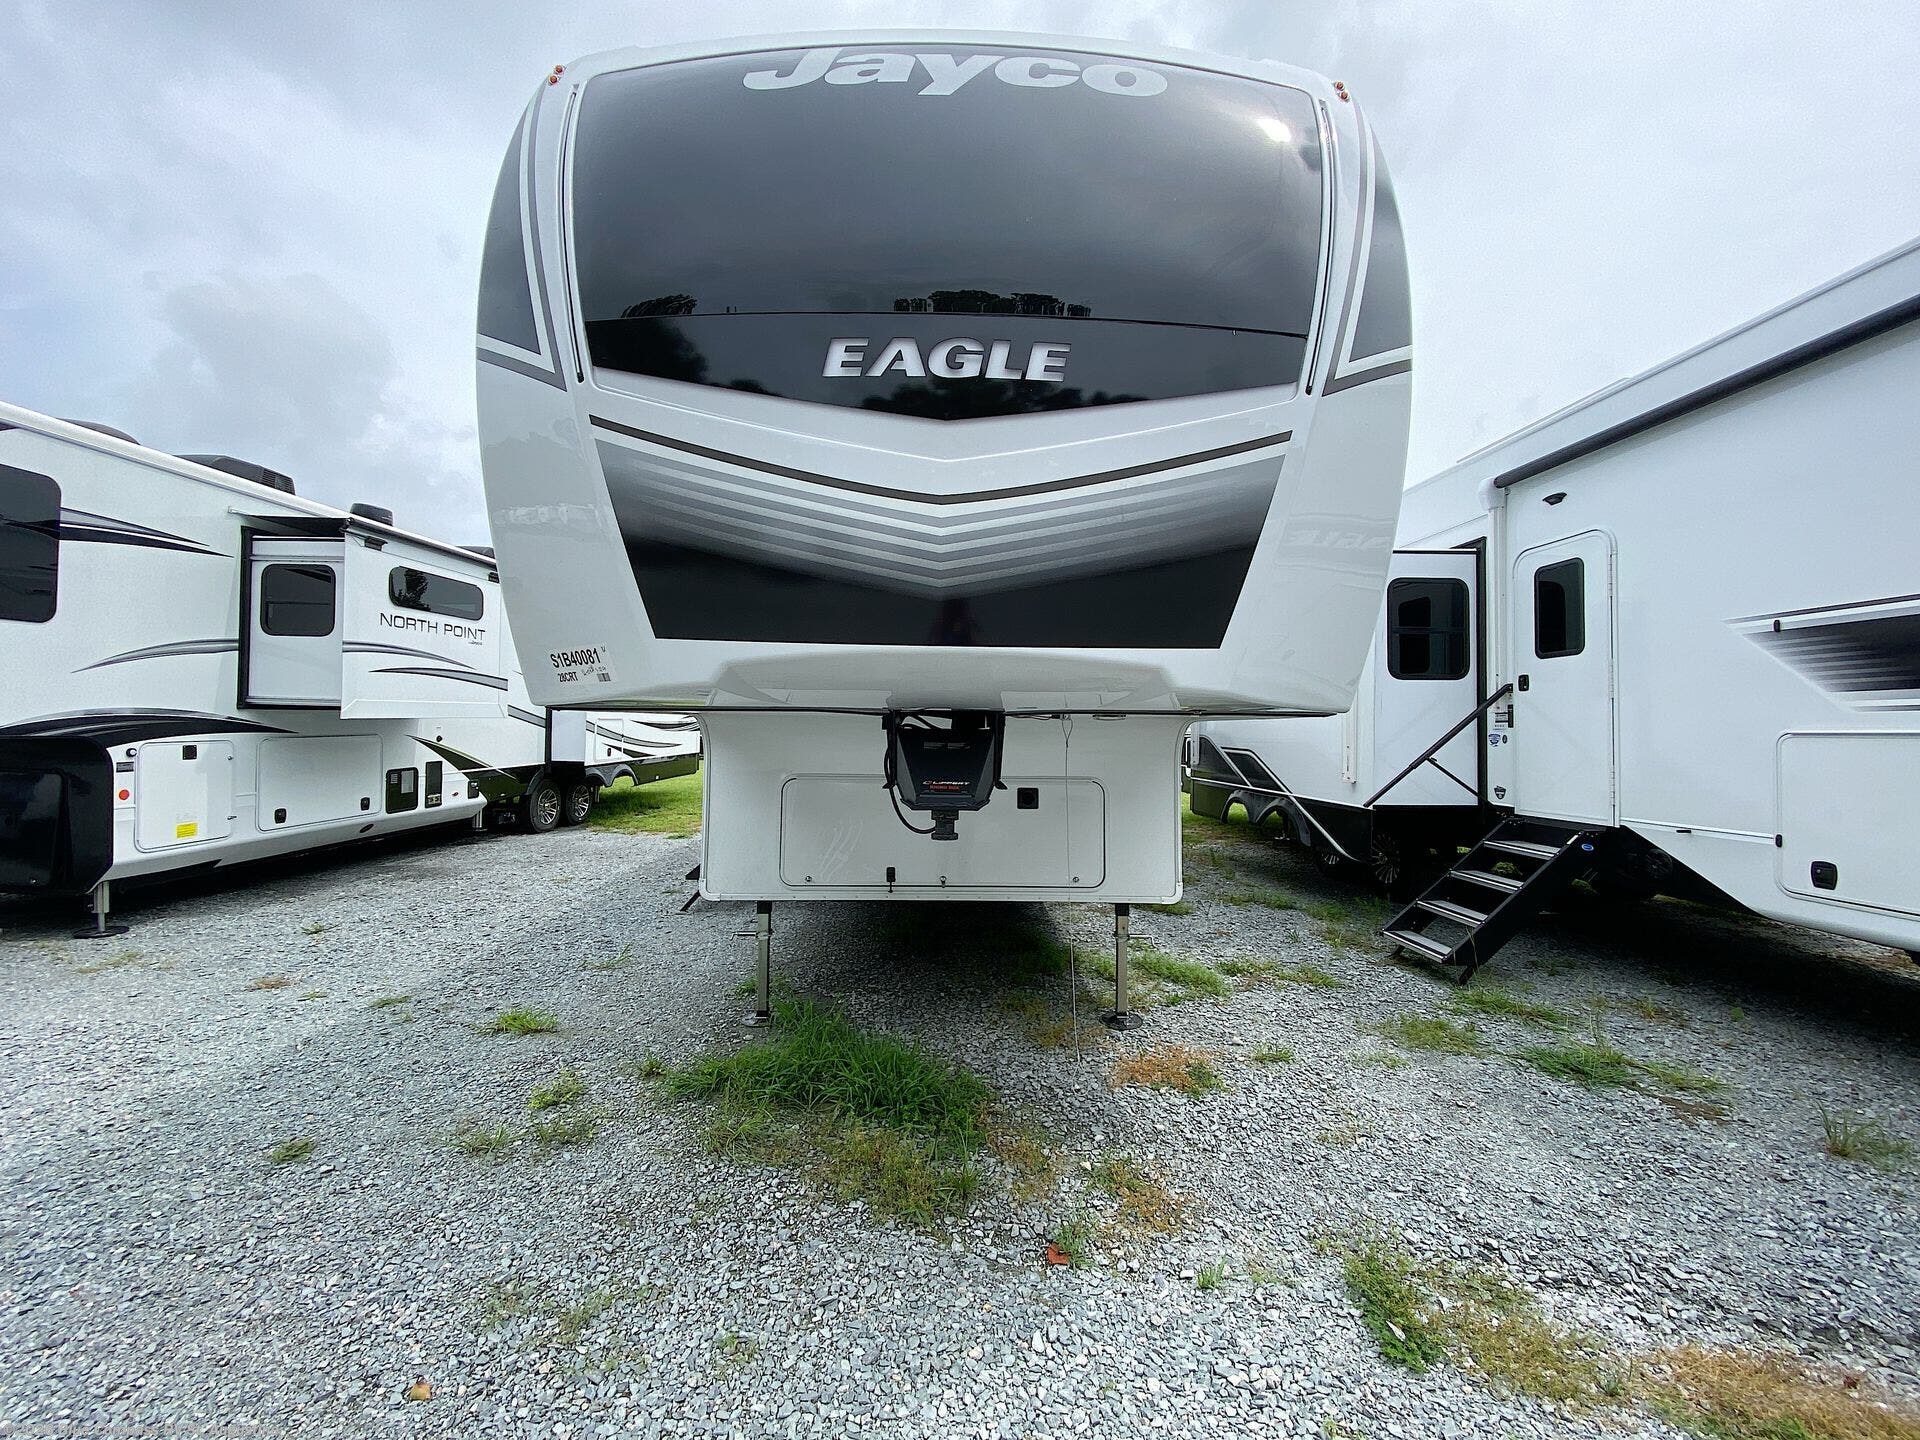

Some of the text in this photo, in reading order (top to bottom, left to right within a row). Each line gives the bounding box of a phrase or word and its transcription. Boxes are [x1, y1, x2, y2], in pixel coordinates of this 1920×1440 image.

[743, 47, 1167, 97] Jayco
[822, 337, 1072, 382] EAGLE
[380, 612, 486, 641] NORTH POINT
[550, 647, 601, 668] S1B40081
